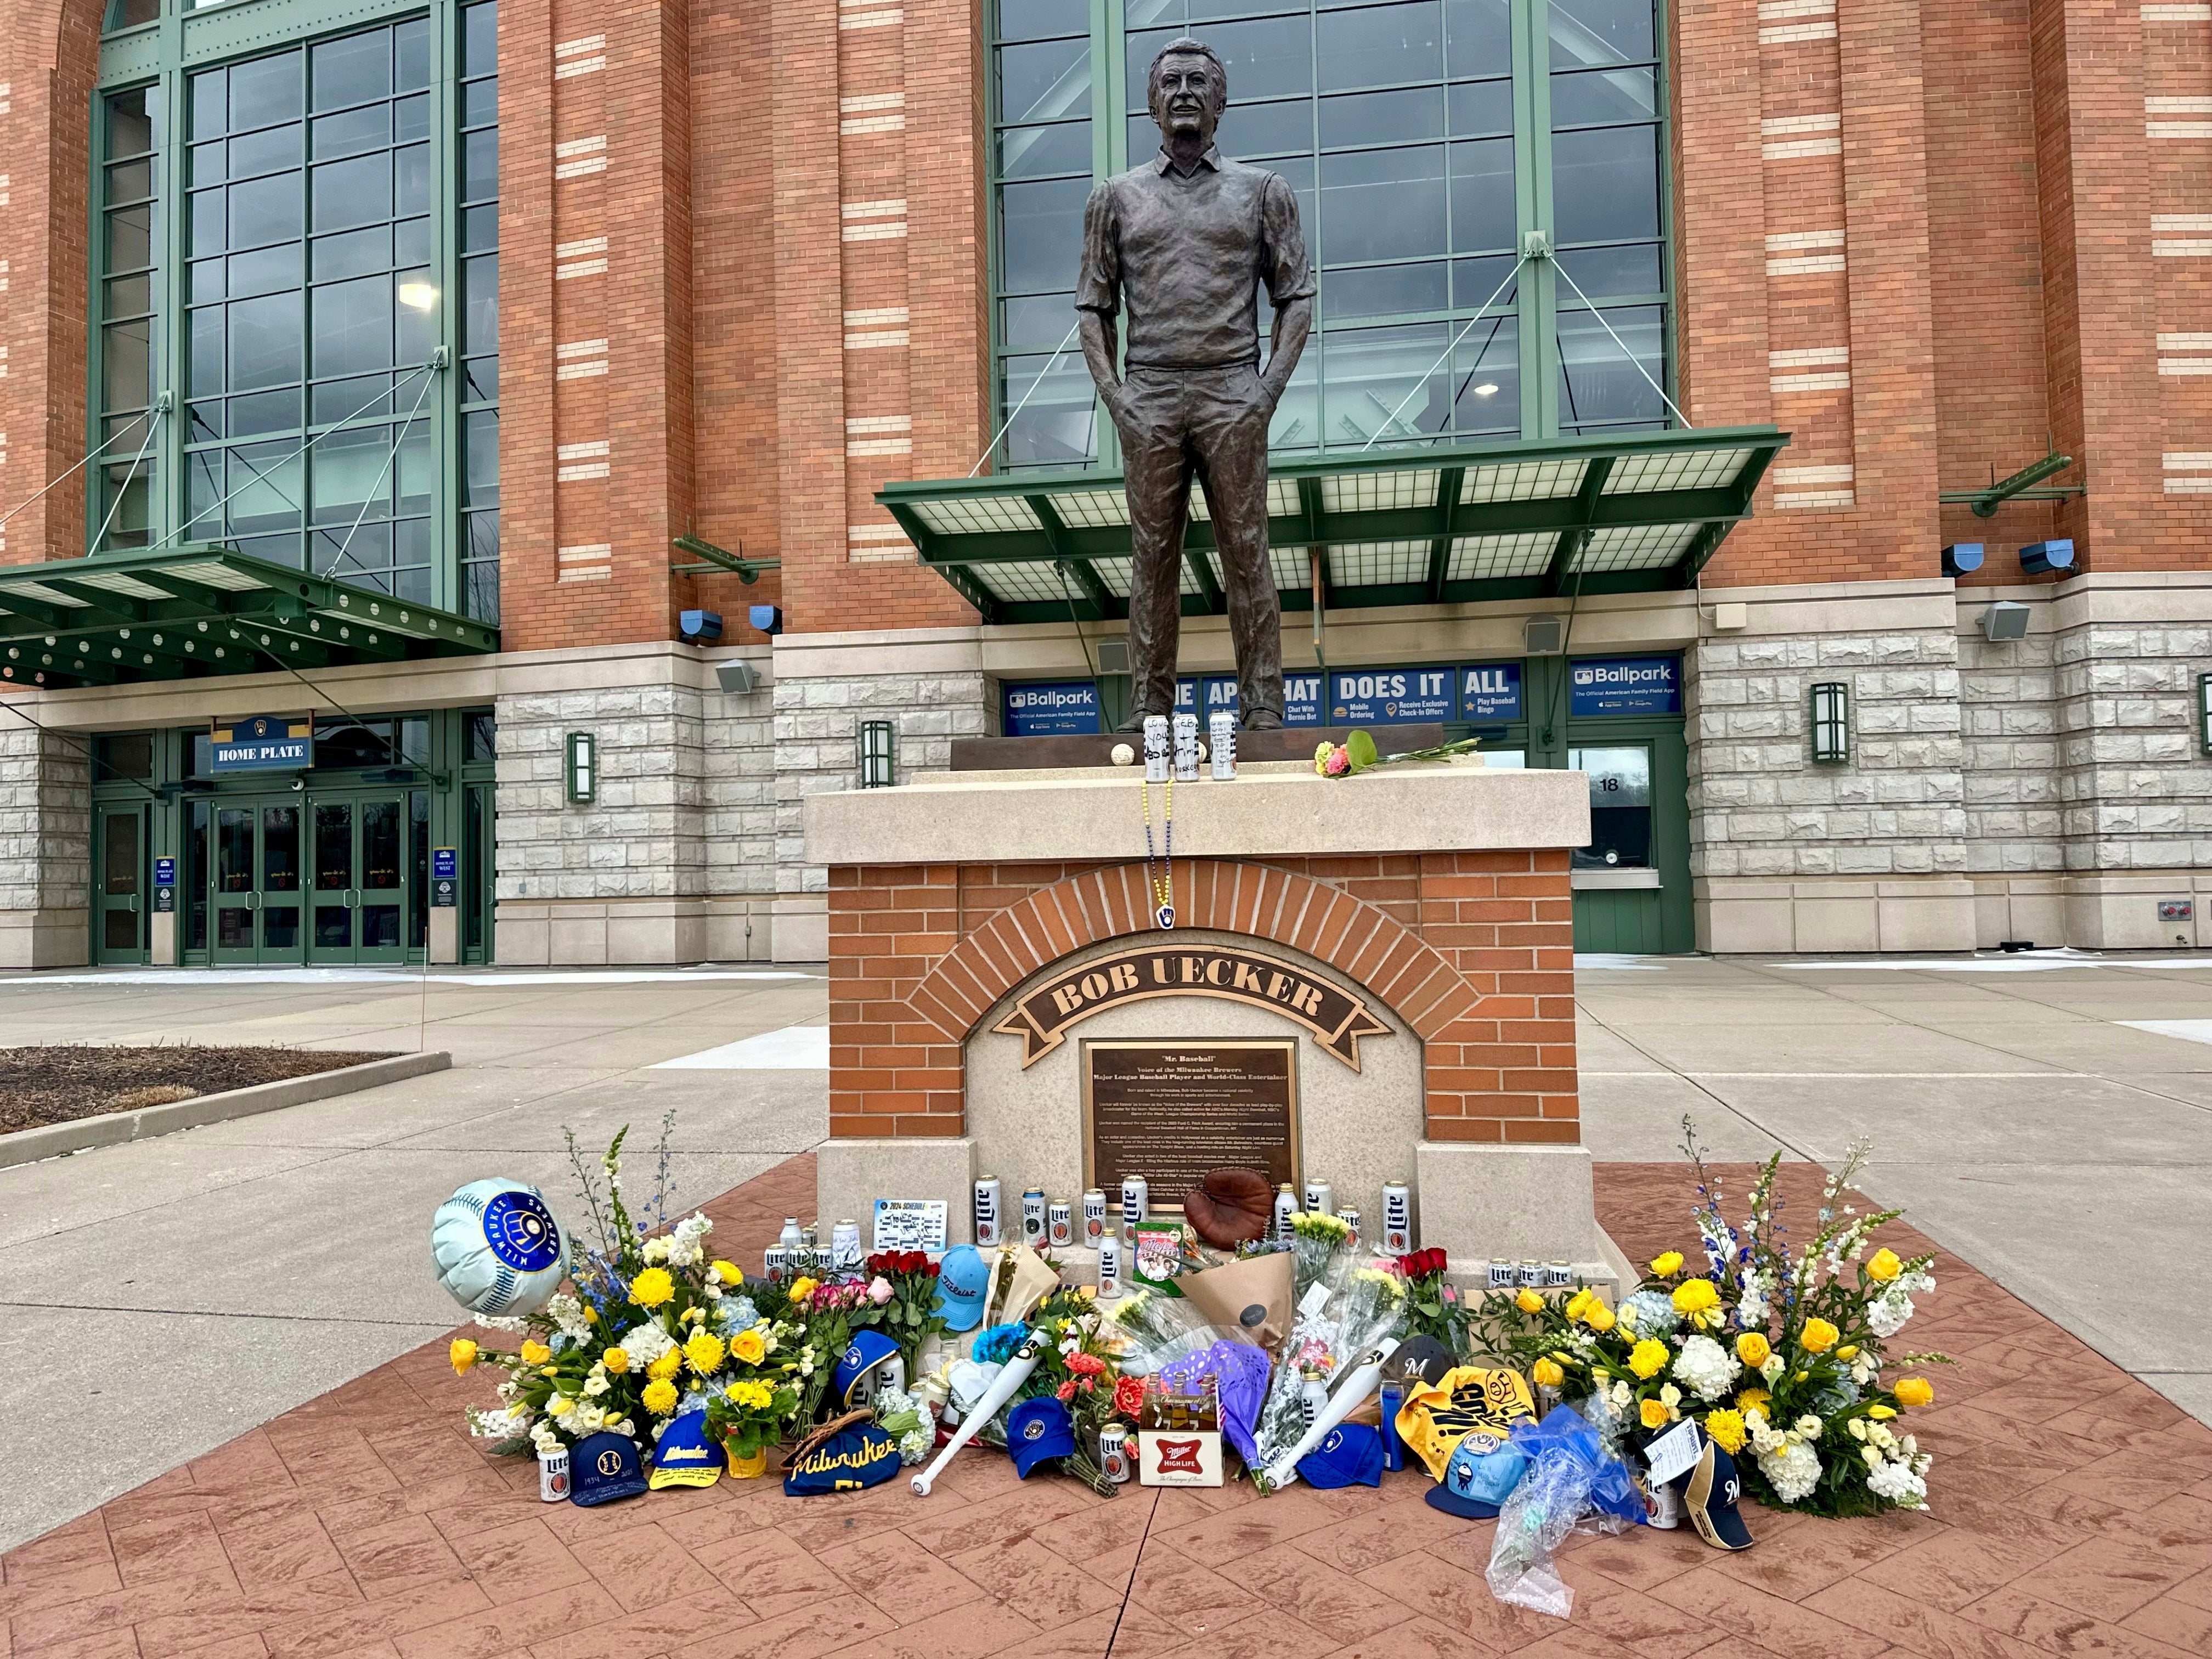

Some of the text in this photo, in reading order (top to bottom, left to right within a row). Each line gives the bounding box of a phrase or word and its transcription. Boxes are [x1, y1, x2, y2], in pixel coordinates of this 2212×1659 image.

[1595, 665, 1671, 684] Ballpark
[1209, 682, 1238, 704] AP
[1283, 670, 1509, 701] HAT DOES IT ALL
[1027, 690, 1092, 708] Ballpark
[1148, 718, 1167, 727] LOVE
[219, 745, 303, 761] HOME PLATE
[1600, 778, 1618, 792] 18
[1050, 957, 1324, 1017] BOB UECKER
[889, 1202, 926, 1210] 2024 SCHEDULE
[977, 1189, 995, 1223] Lite
[1024, 1204, 1040, 1215] Lite
[1124, 1189, 1142, 1223] Lite
[1307, 1192, 1319, 1211] te
[1051, 1209, 1069, 1222] Lite
[1085, 1204, 1104, 1218] Lite
[1281, 1207, 1295, 1232] Lite
[1387, 1195, 1407, 1231] Lite
[489, 1200, 528, 1266] MILWAUKEE
[528, 1199, 557, 1255] BREWERS
[767, 1253, 785, 1266] Lite
[1102, 1251, 1116, 1278] Lite
[1492, 1268, 1511, 1282] Lite
[1519, 1269, 1534, 1282] ite
[1548, 1269, 1567, 1284] Lite
[941, 1274, 977, 1297] Titleist
[1404, 1358, 1431, 1375] M
[1102, 1438, 1123, 1454] Lite
[1166, 1446, 1192, 1459] Miller
[547, 1456, 568, 1474] Lite
[790, 1436, 897, 1482] Milwaukee
[584, 1476, 600, 1485] 1934
[1725, 1474, 1740, 1502] M
